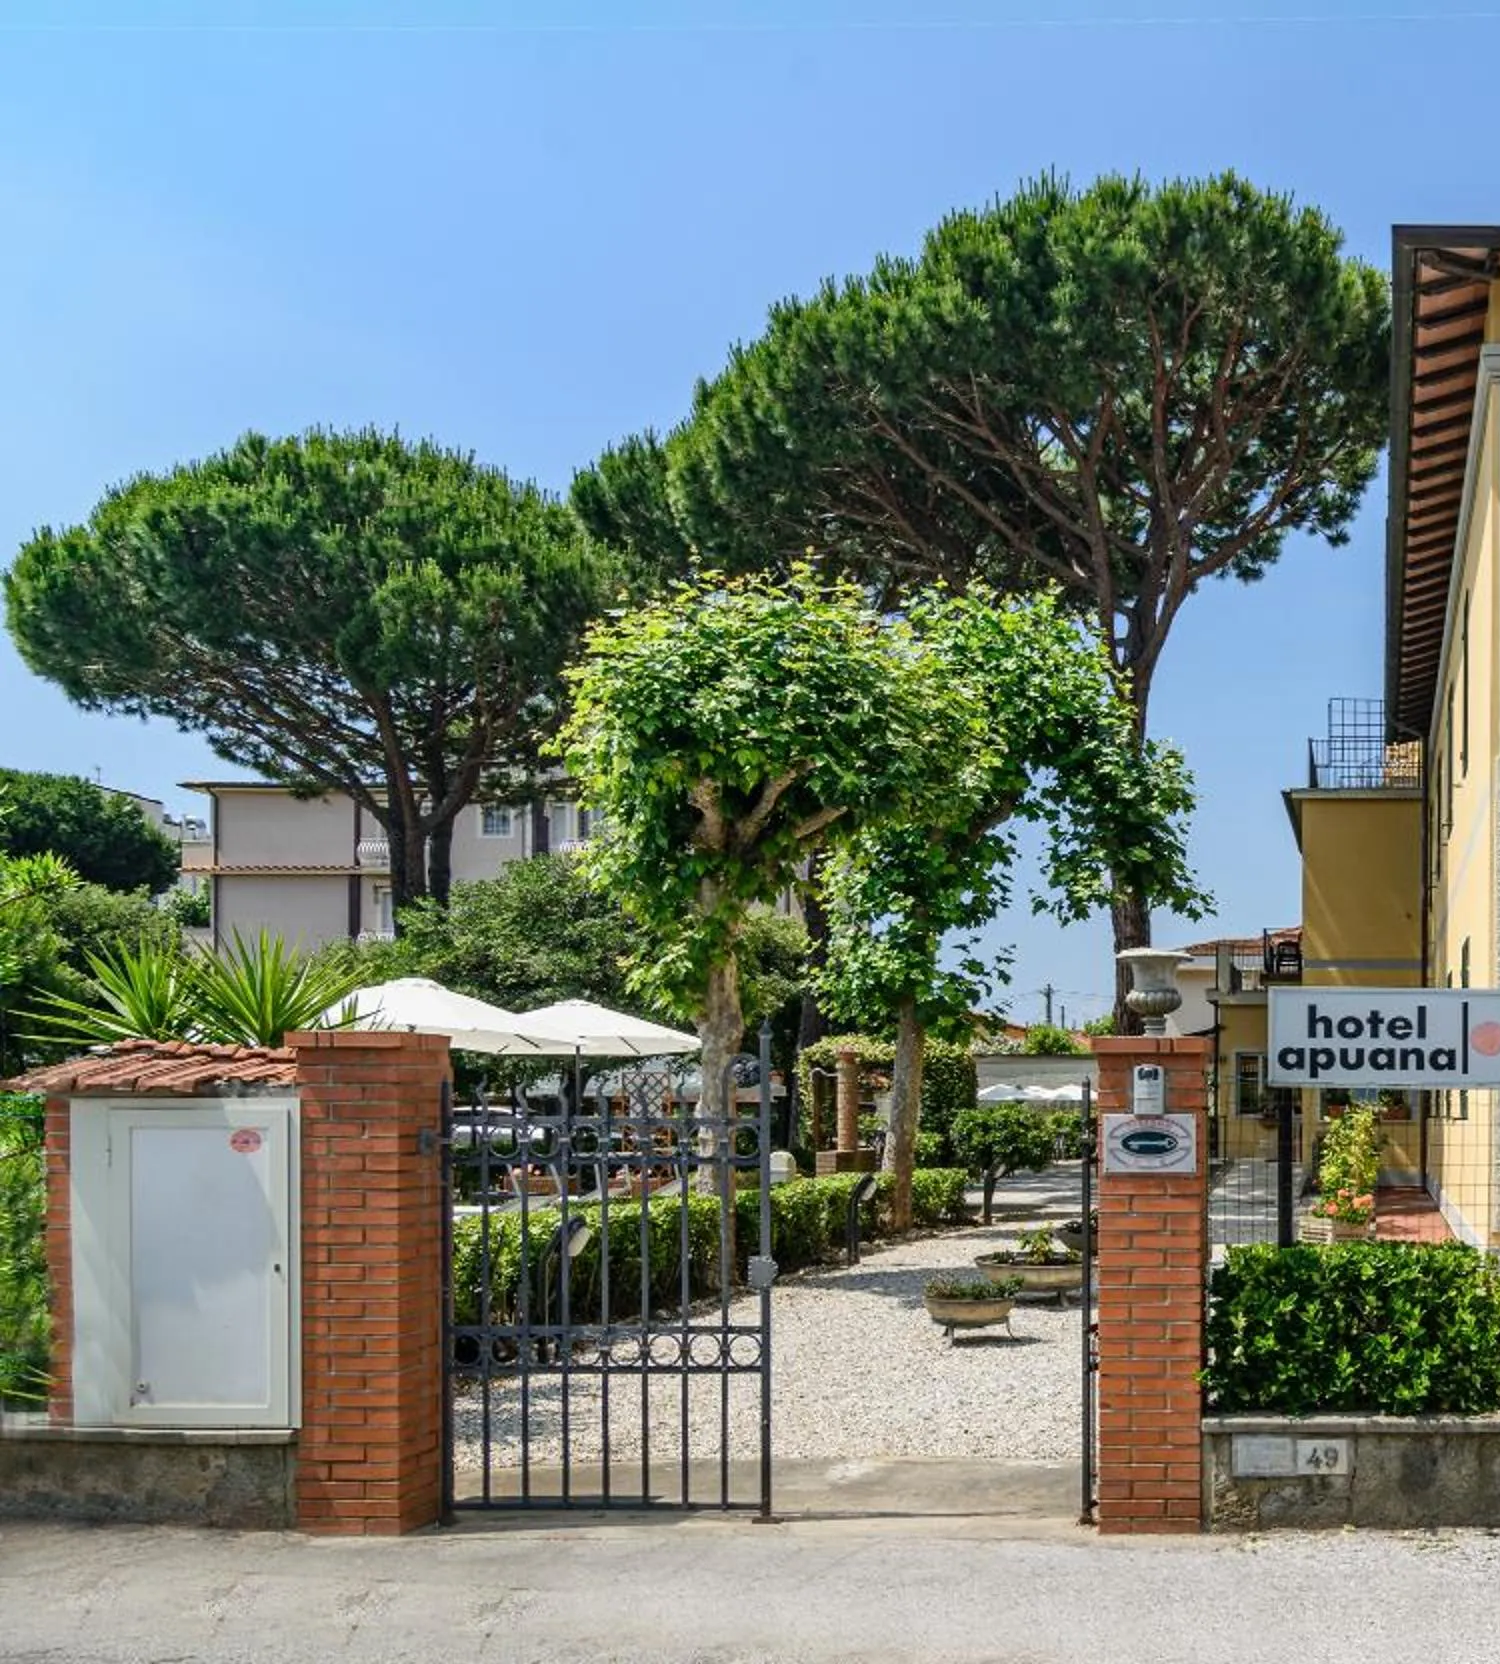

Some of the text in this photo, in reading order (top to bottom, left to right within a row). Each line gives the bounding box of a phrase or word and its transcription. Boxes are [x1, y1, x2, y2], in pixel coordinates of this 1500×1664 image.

[1307, 1004, 1427, 1040] hotel
[1277, 1047, 1457, 1079] apuana
[1305, 1446, 1339, 1469] 49
